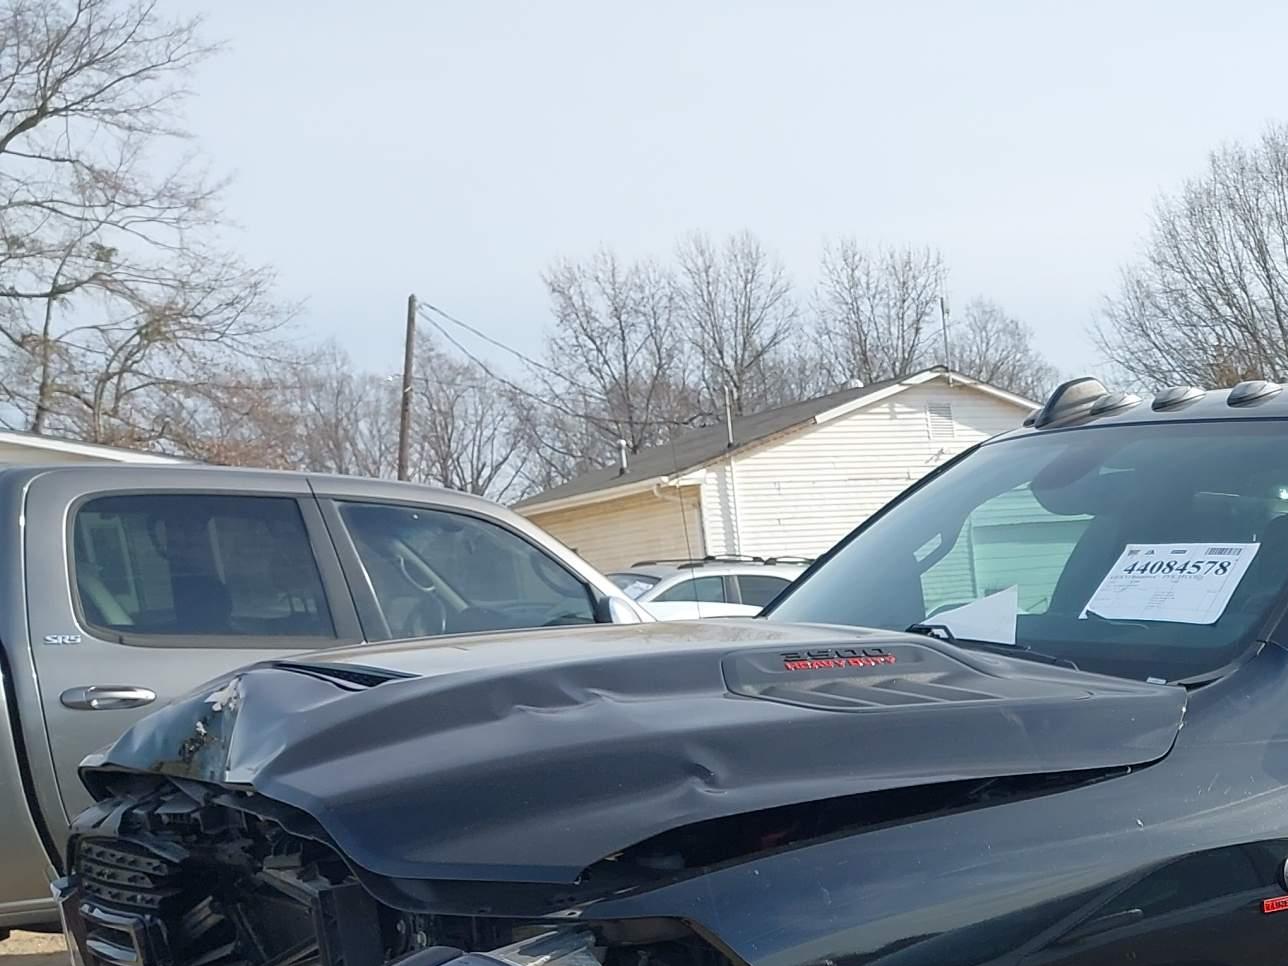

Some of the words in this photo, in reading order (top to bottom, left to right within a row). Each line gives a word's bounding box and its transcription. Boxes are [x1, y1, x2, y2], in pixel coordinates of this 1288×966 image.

[1123, 560, 1232, 576] 44084578
[780, 648, 890, 662] 3500
[784, 658, 846, 671] HEAVY
[847, 655, 897, 667] DUTY
